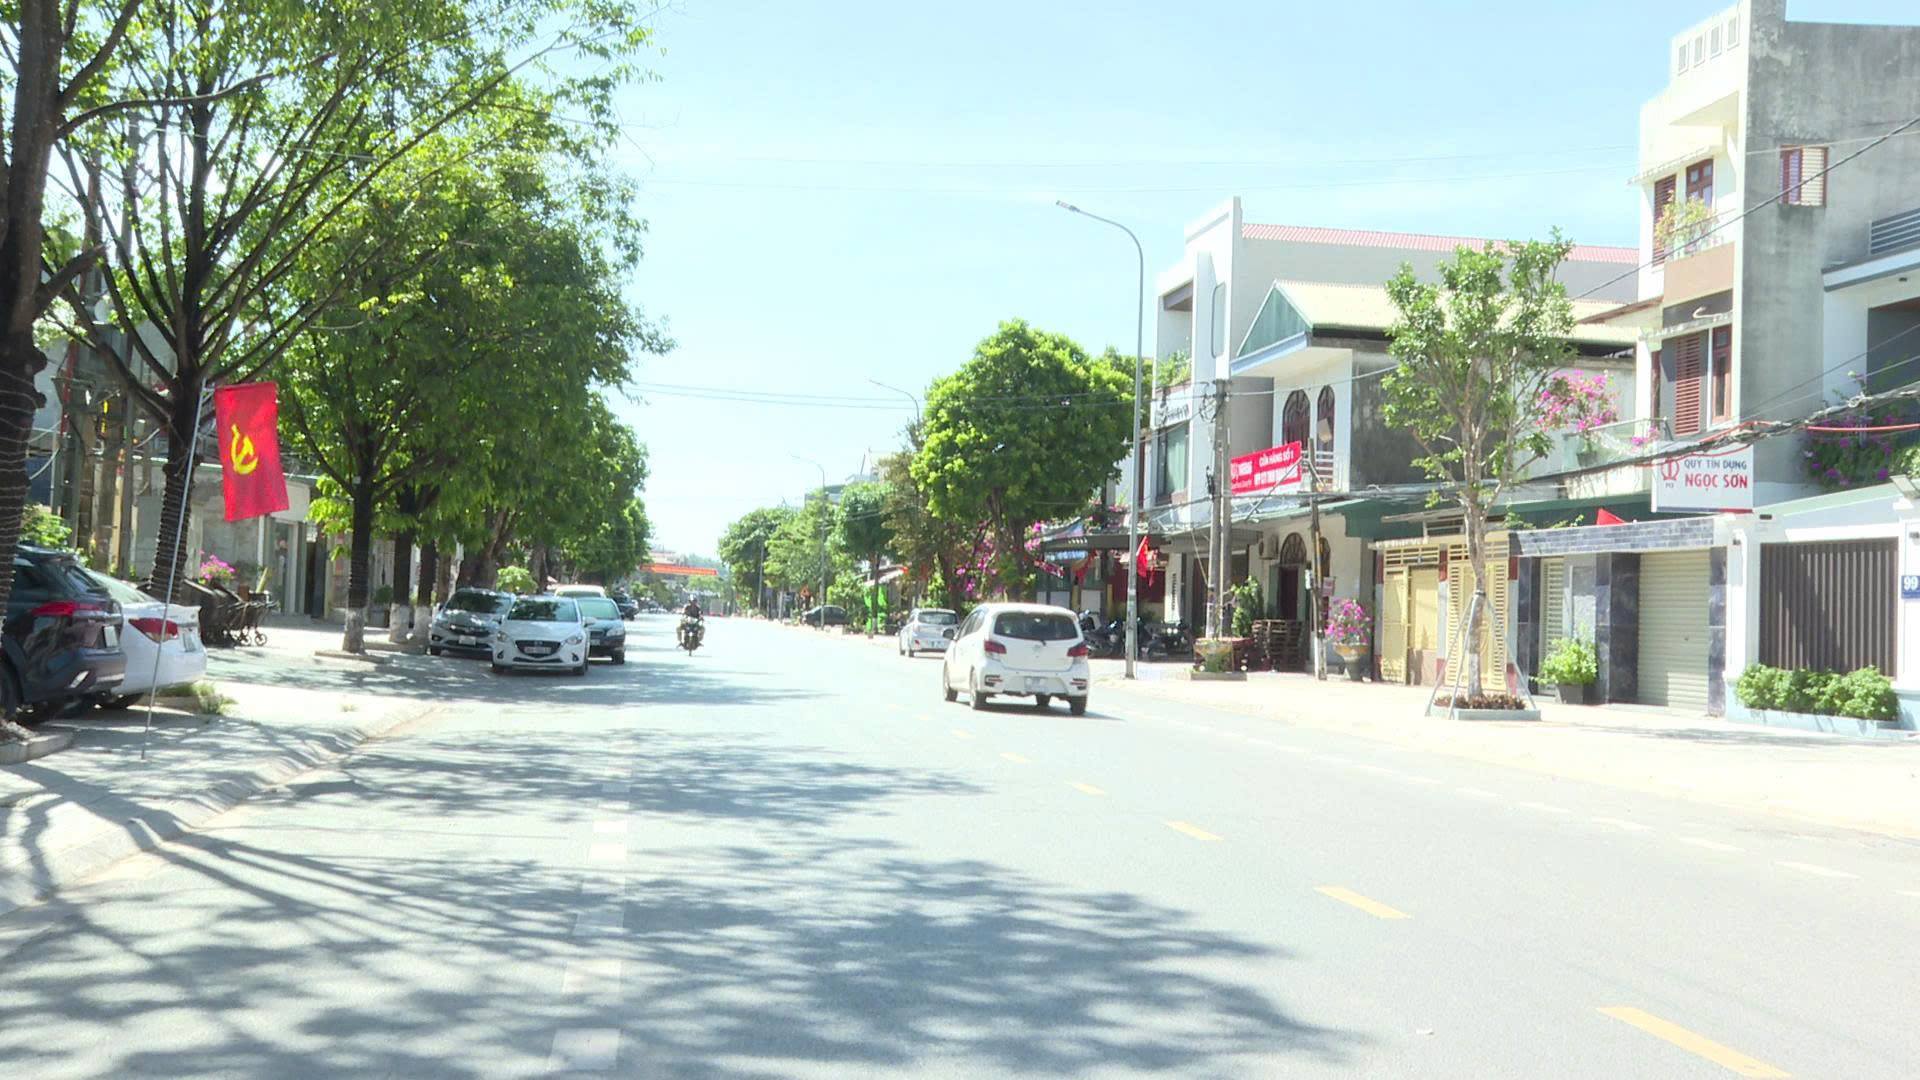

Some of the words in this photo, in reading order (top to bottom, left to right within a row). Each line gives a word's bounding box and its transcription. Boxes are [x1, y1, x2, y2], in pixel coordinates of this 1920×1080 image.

[1723, 459, 1747, 472] DỤNG
[1685, 473, 1719, 492] NGỌC
[1723, 473, 1748, 489] SƠN
